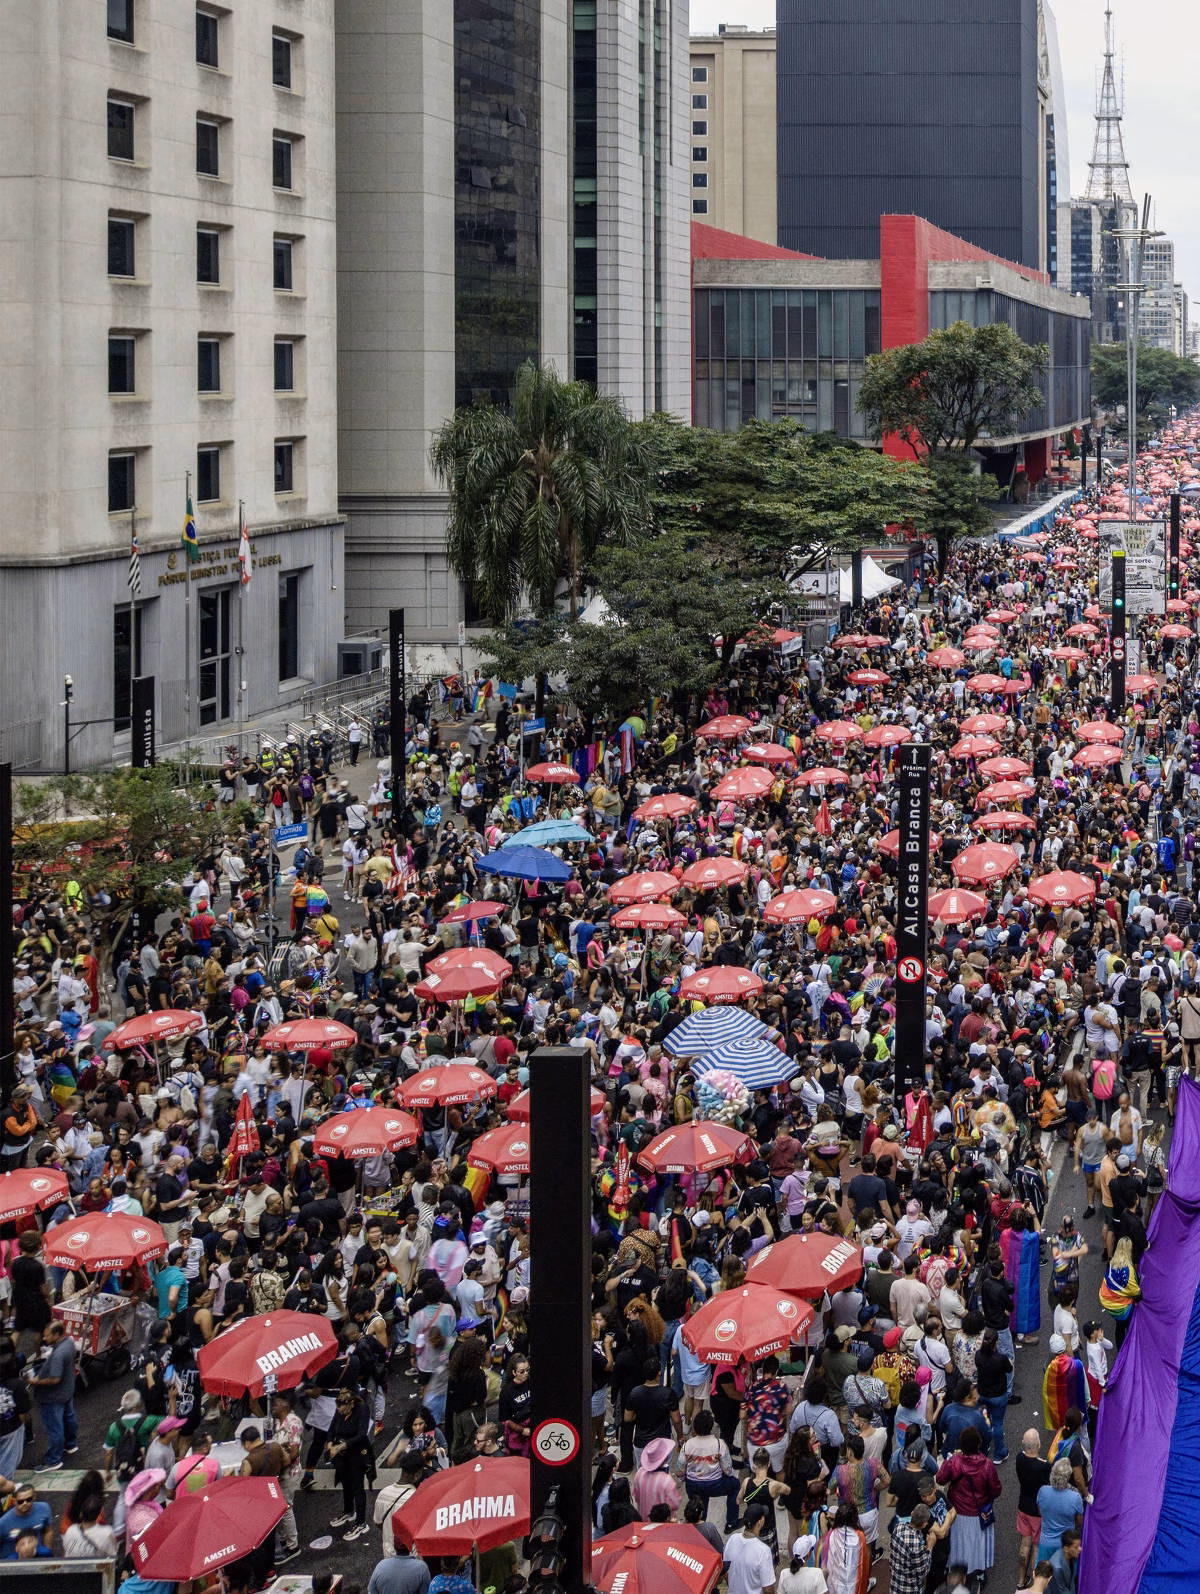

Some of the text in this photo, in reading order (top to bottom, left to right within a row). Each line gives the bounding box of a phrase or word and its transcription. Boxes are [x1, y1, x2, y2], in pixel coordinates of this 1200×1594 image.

[143, 709, 152, 768] Paulista
[906, 787, 921, 852] Branca
[159, 1027, 179, 1037] AMSTEL
[124, 1037, 145, 1046] AMSTEL
[445, 1094, 468, 1102] AMSTEL
[320, 1145, 337, 1155] AMSTEL
[392, 1137, 412, 1149] AMSTEL
[652, 1134, 677, 1155] BRAHMA
[352, 1147, 376, 1155] AMSTEL
[44, 1191, 64, 1206] AMSTEL
[0, 1207, 27, 1221] AMSTEL
[53, 1255, 76, 1267] AMSTEL
[142, 1247, 161, 1261] AMSTEL
[94, 1258, 124, 1269] AMSTEL
[796, 1317, 810, 1336] AMSTEL
[256, 1332, 323, 1374] BRAHMA
[754, 1341, 782, 1357] AMSTEL
[706, 1351, 733, 1362] AMSTEL
[435, 1494, 516, 1532] BRAHMA
[203, 1544, 236, 1565] AMSTEL
[666, 1546, 704, 1574] BRAHMA
